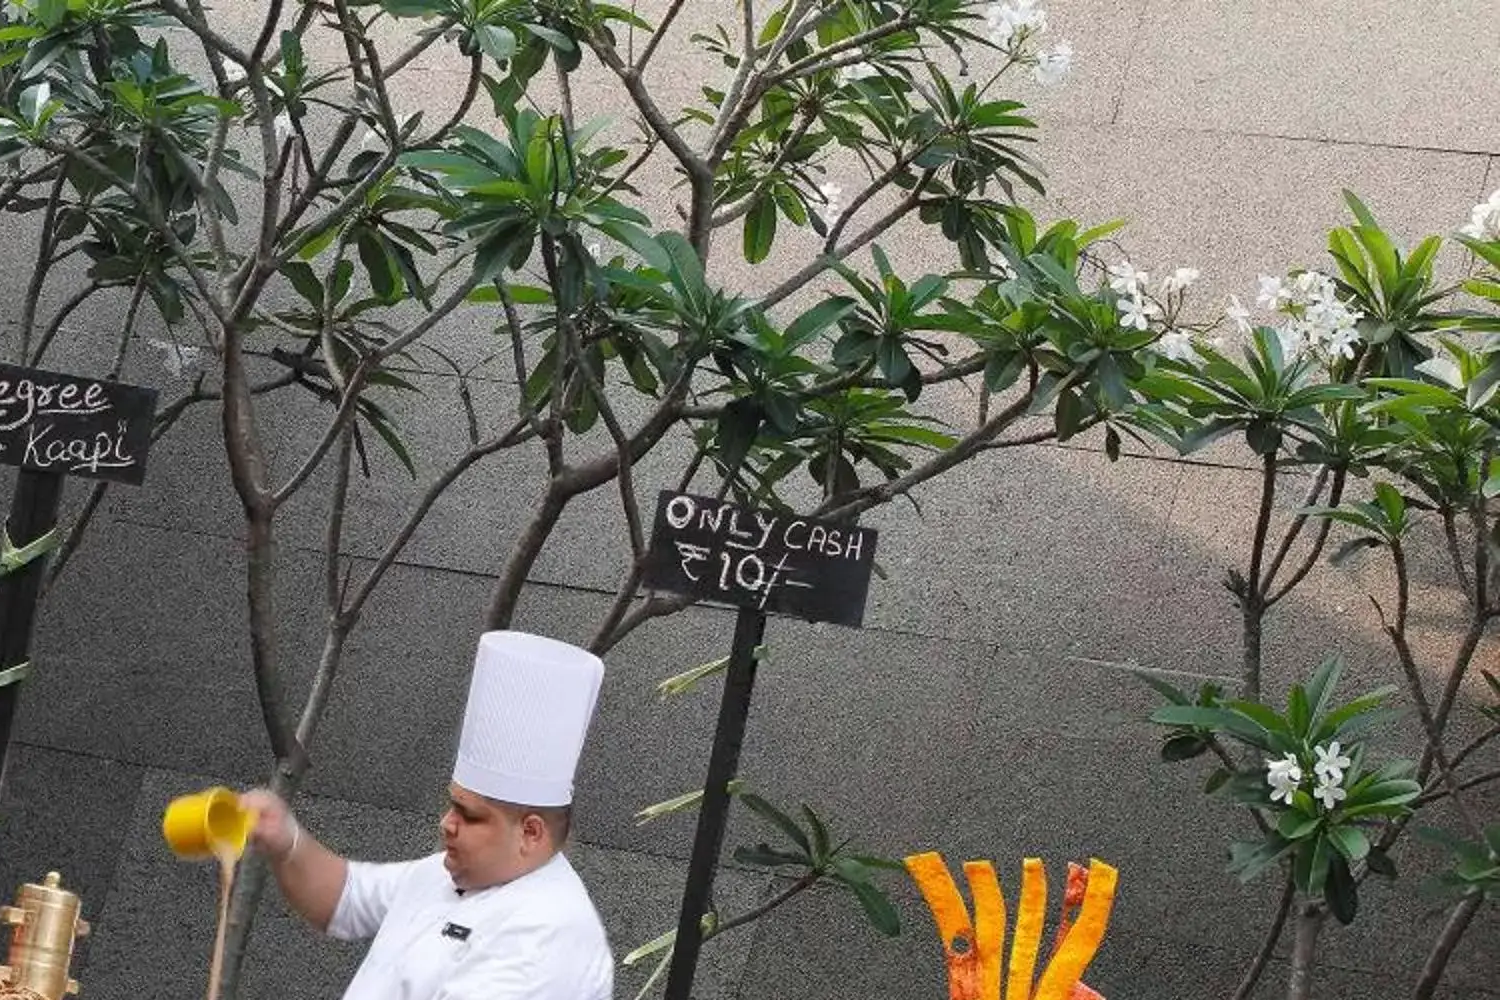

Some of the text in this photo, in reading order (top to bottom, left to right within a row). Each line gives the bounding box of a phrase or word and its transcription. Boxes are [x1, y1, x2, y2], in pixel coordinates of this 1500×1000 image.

[22, 418, 134, 472] Kaapi
[666, 496, 864, 561] ONLY CASH
